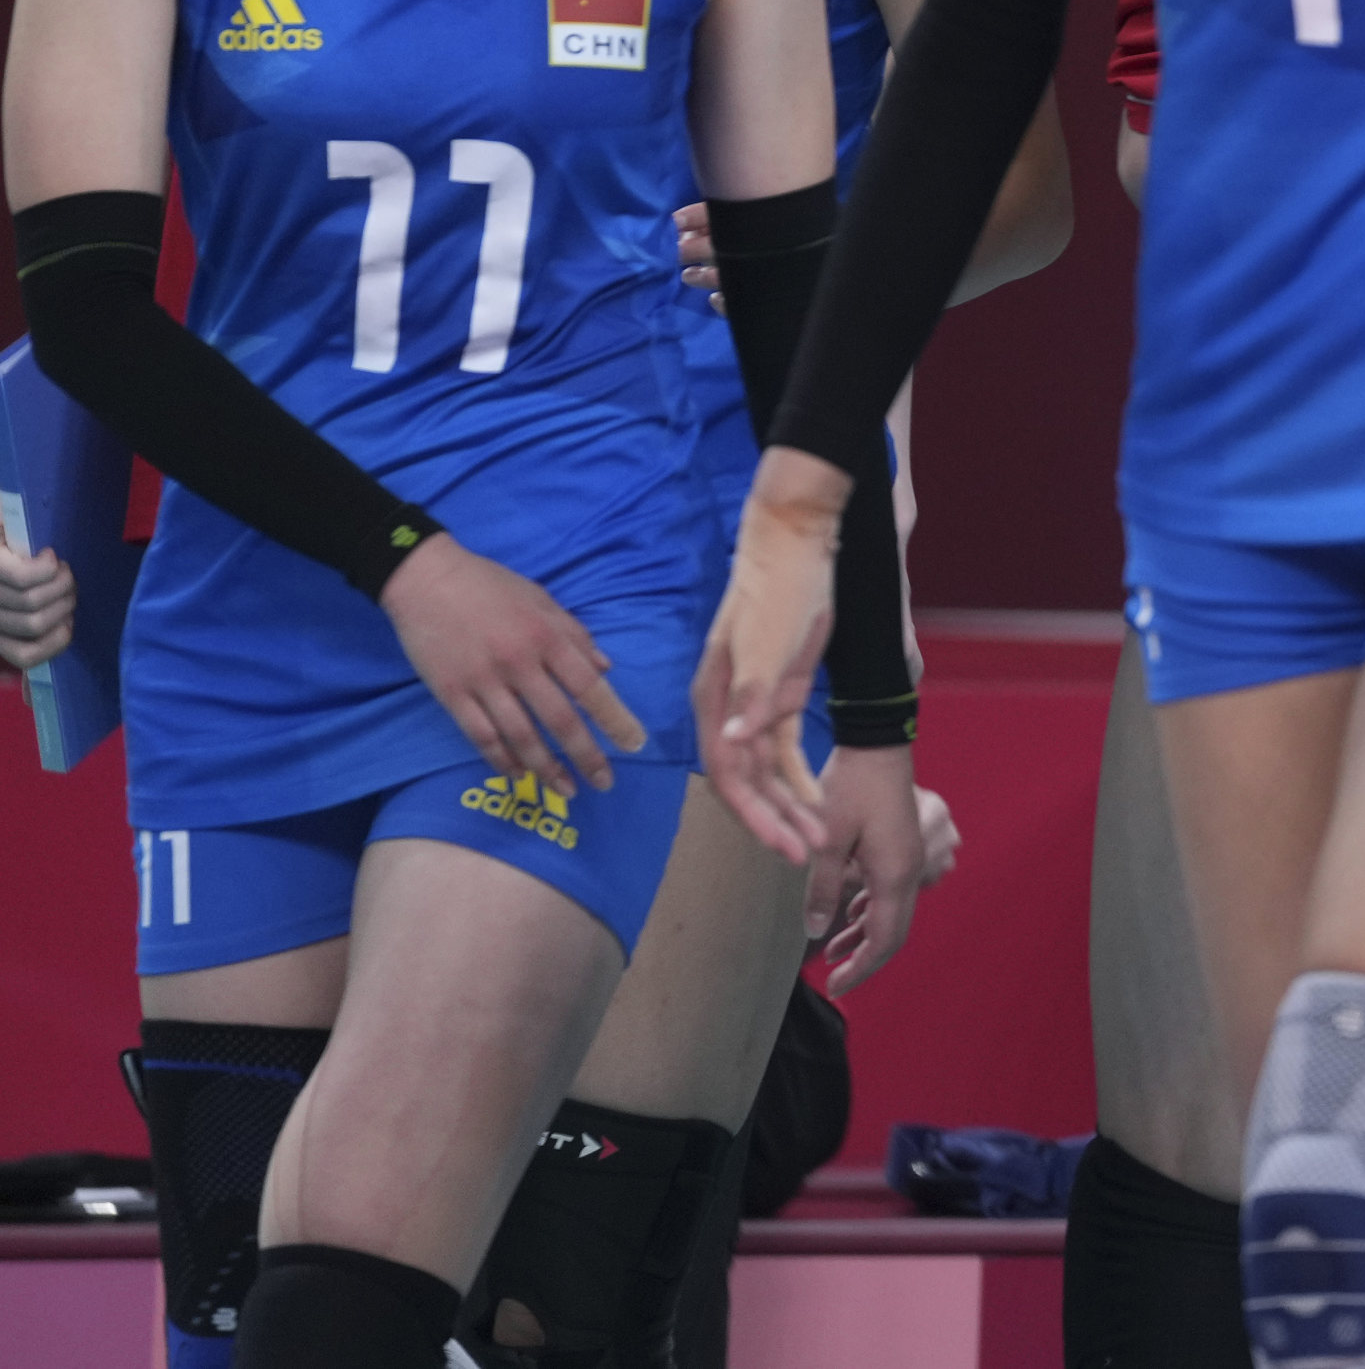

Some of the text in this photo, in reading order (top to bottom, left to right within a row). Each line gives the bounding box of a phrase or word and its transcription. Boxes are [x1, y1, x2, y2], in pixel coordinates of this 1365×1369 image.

[218, 24, 323, 51] adidas
[564, 33, 637, 64] CHN
[326, 139, 535, 374] 11
[460, 787, 579, 850] adidas
